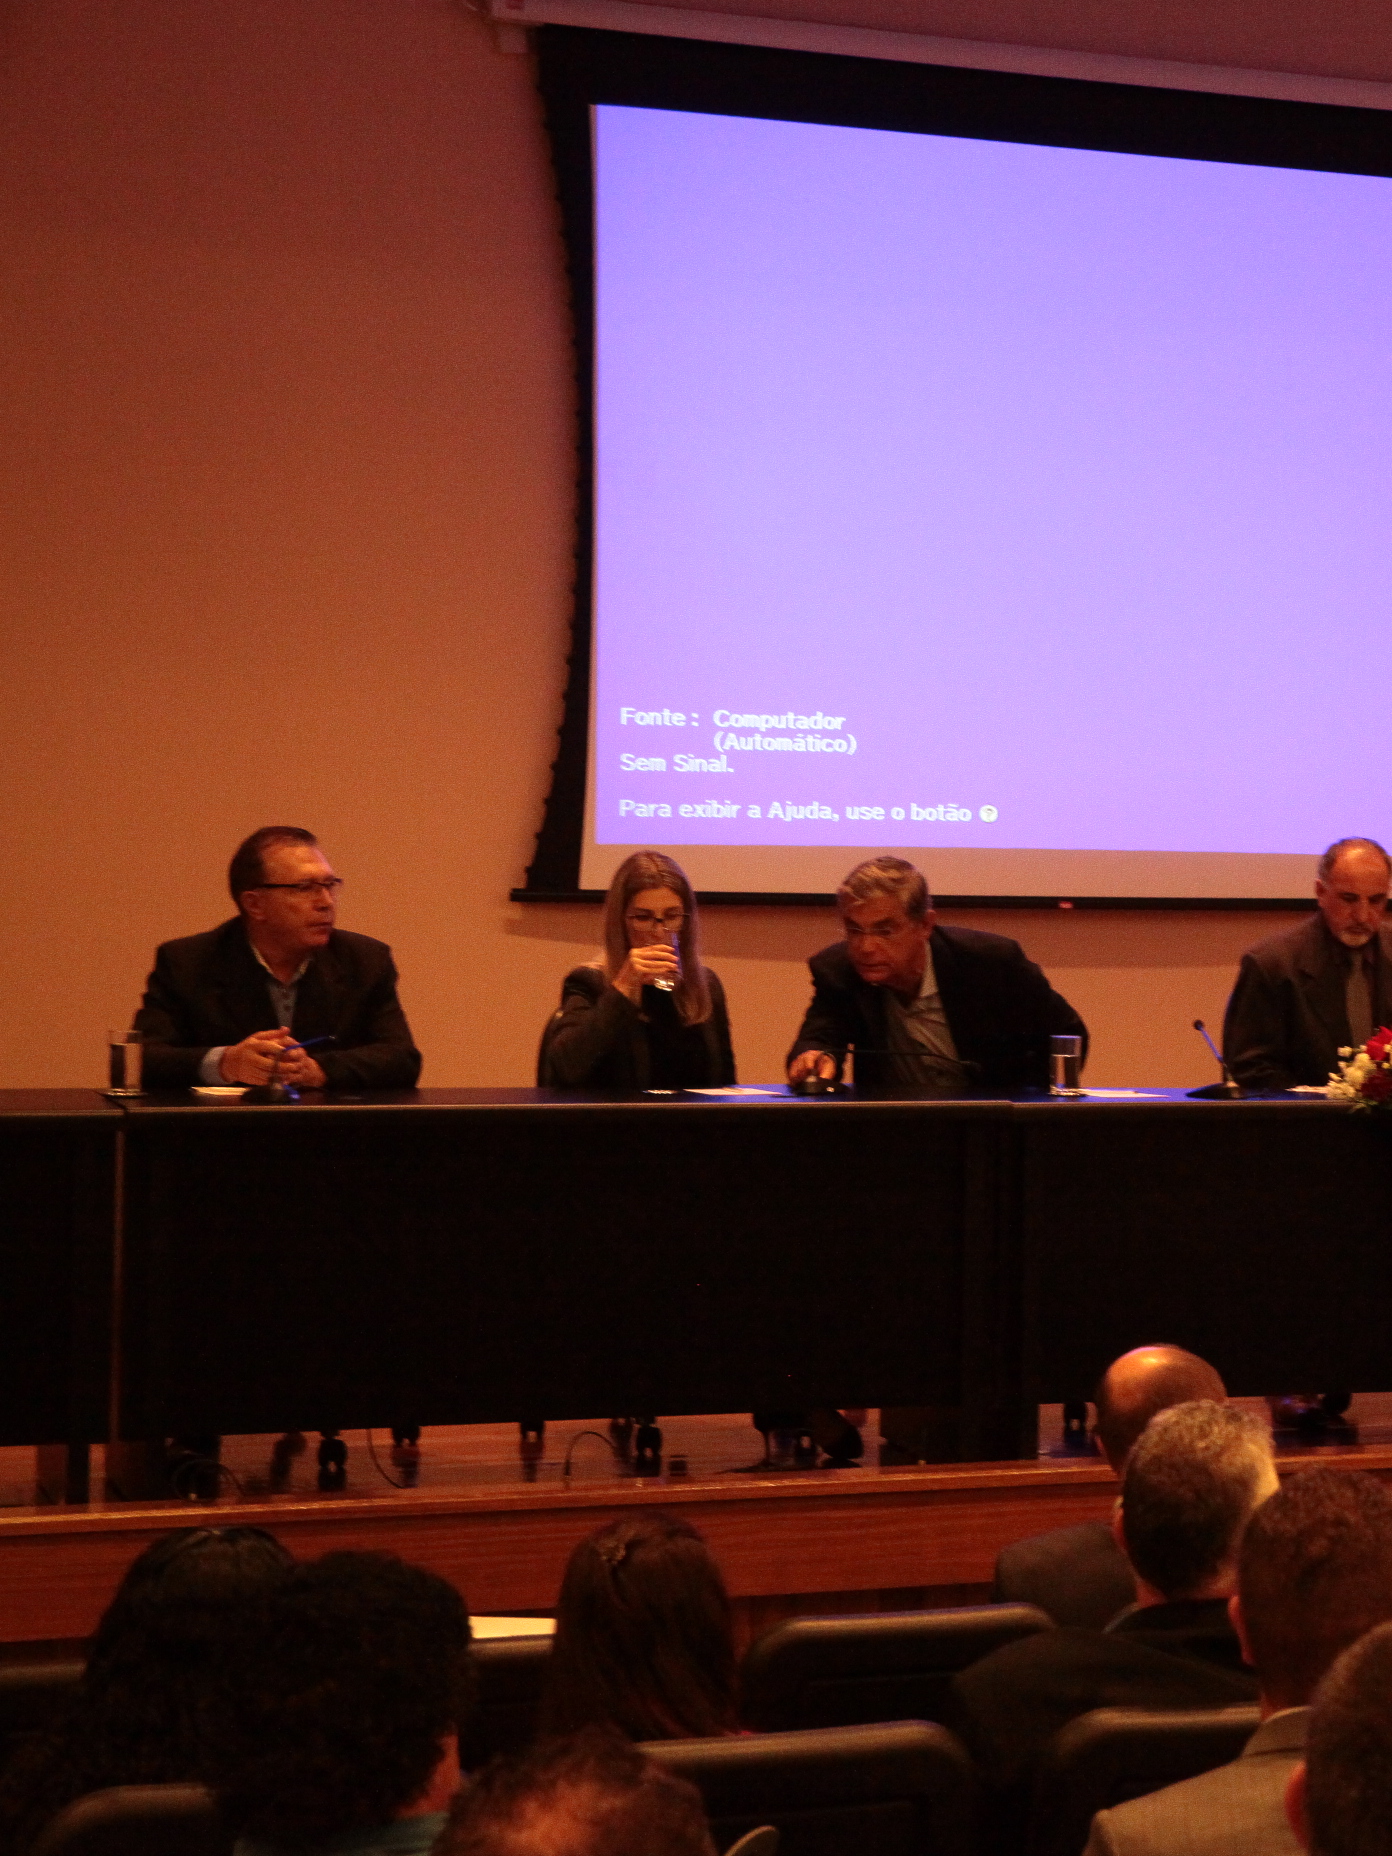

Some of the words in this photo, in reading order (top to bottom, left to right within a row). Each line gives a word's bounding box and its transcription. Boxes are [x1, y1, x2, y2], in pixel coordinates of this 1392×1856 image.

[712, 709, 847, 732] Computador
[713, 731, 858, 756] (Automático)
[620, 752, 667, 772] Sem
[673, 753, 735, 773] Sinal.
[619, 799, 672, 818] Para
[678, 799, 741, 819] exibir
[747, 804, 762, 819] a
[767, 801, 840, 823] Ajuda,
[845, 805, 886, 821] use
[890, 806, 906, 821] o
[910, 802, 972, 822] botão
